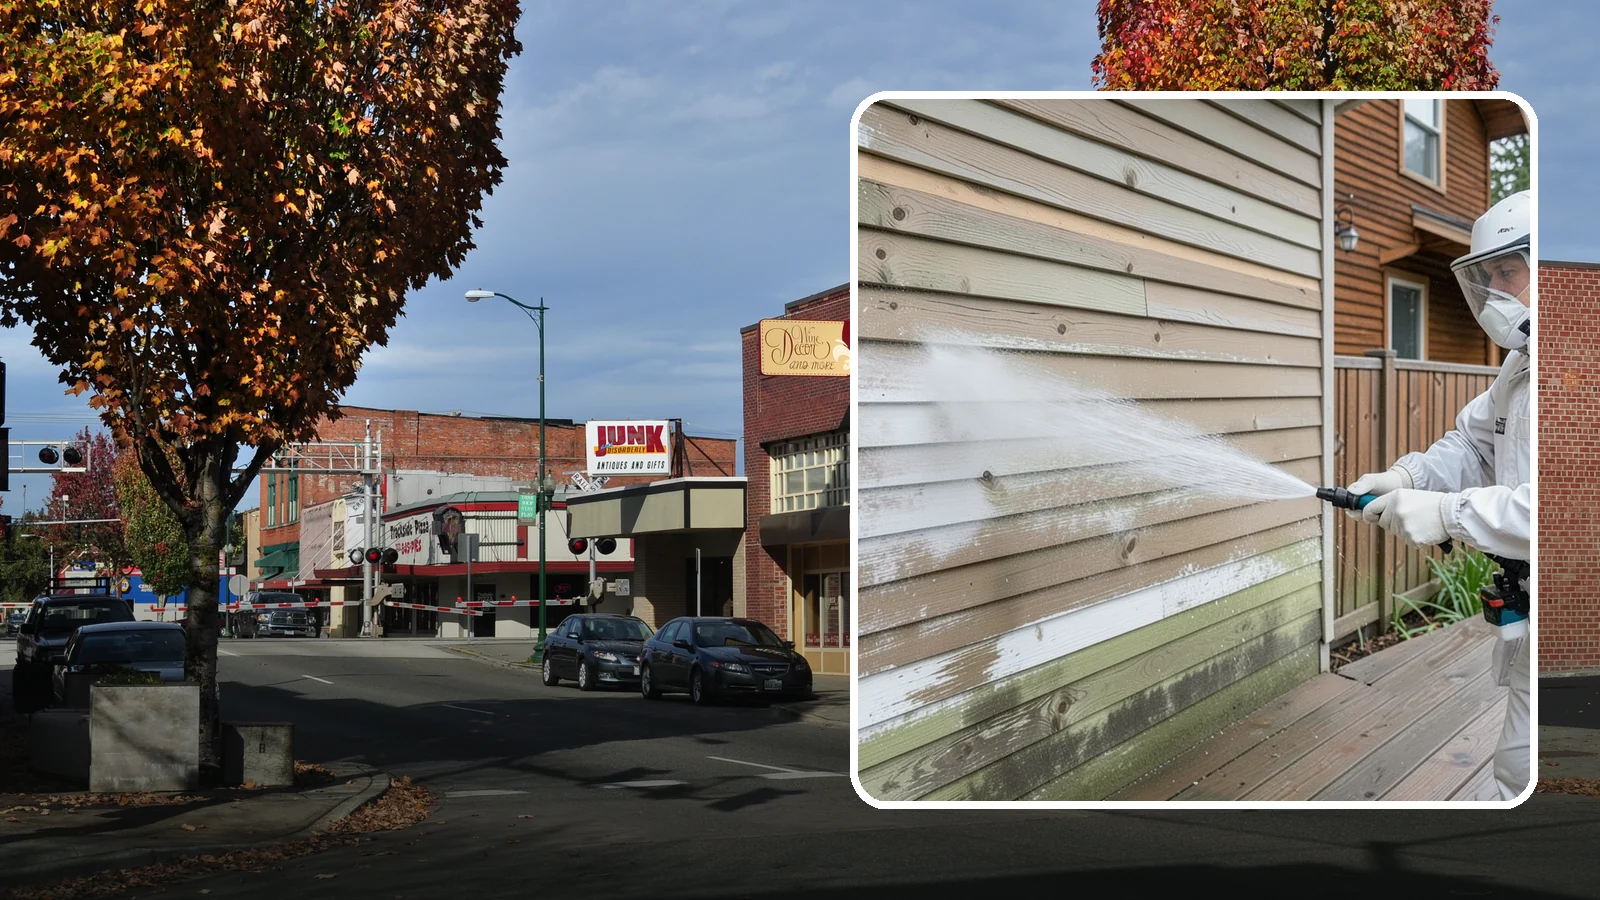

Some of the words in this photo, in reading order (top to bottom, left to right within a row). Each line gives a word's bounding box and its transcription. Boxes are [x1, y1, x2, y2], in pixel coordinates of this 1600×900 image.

[596, 425, 665, 457] JUNK
[607, 446, 646, 454] DISORDERLY
[597, 461, 628, 470] ANTIQUES
[631, 461, 644, 470] AND
[647, 460, 665, 469] GIFTS
[415, 519, 429, 535] Pizza
